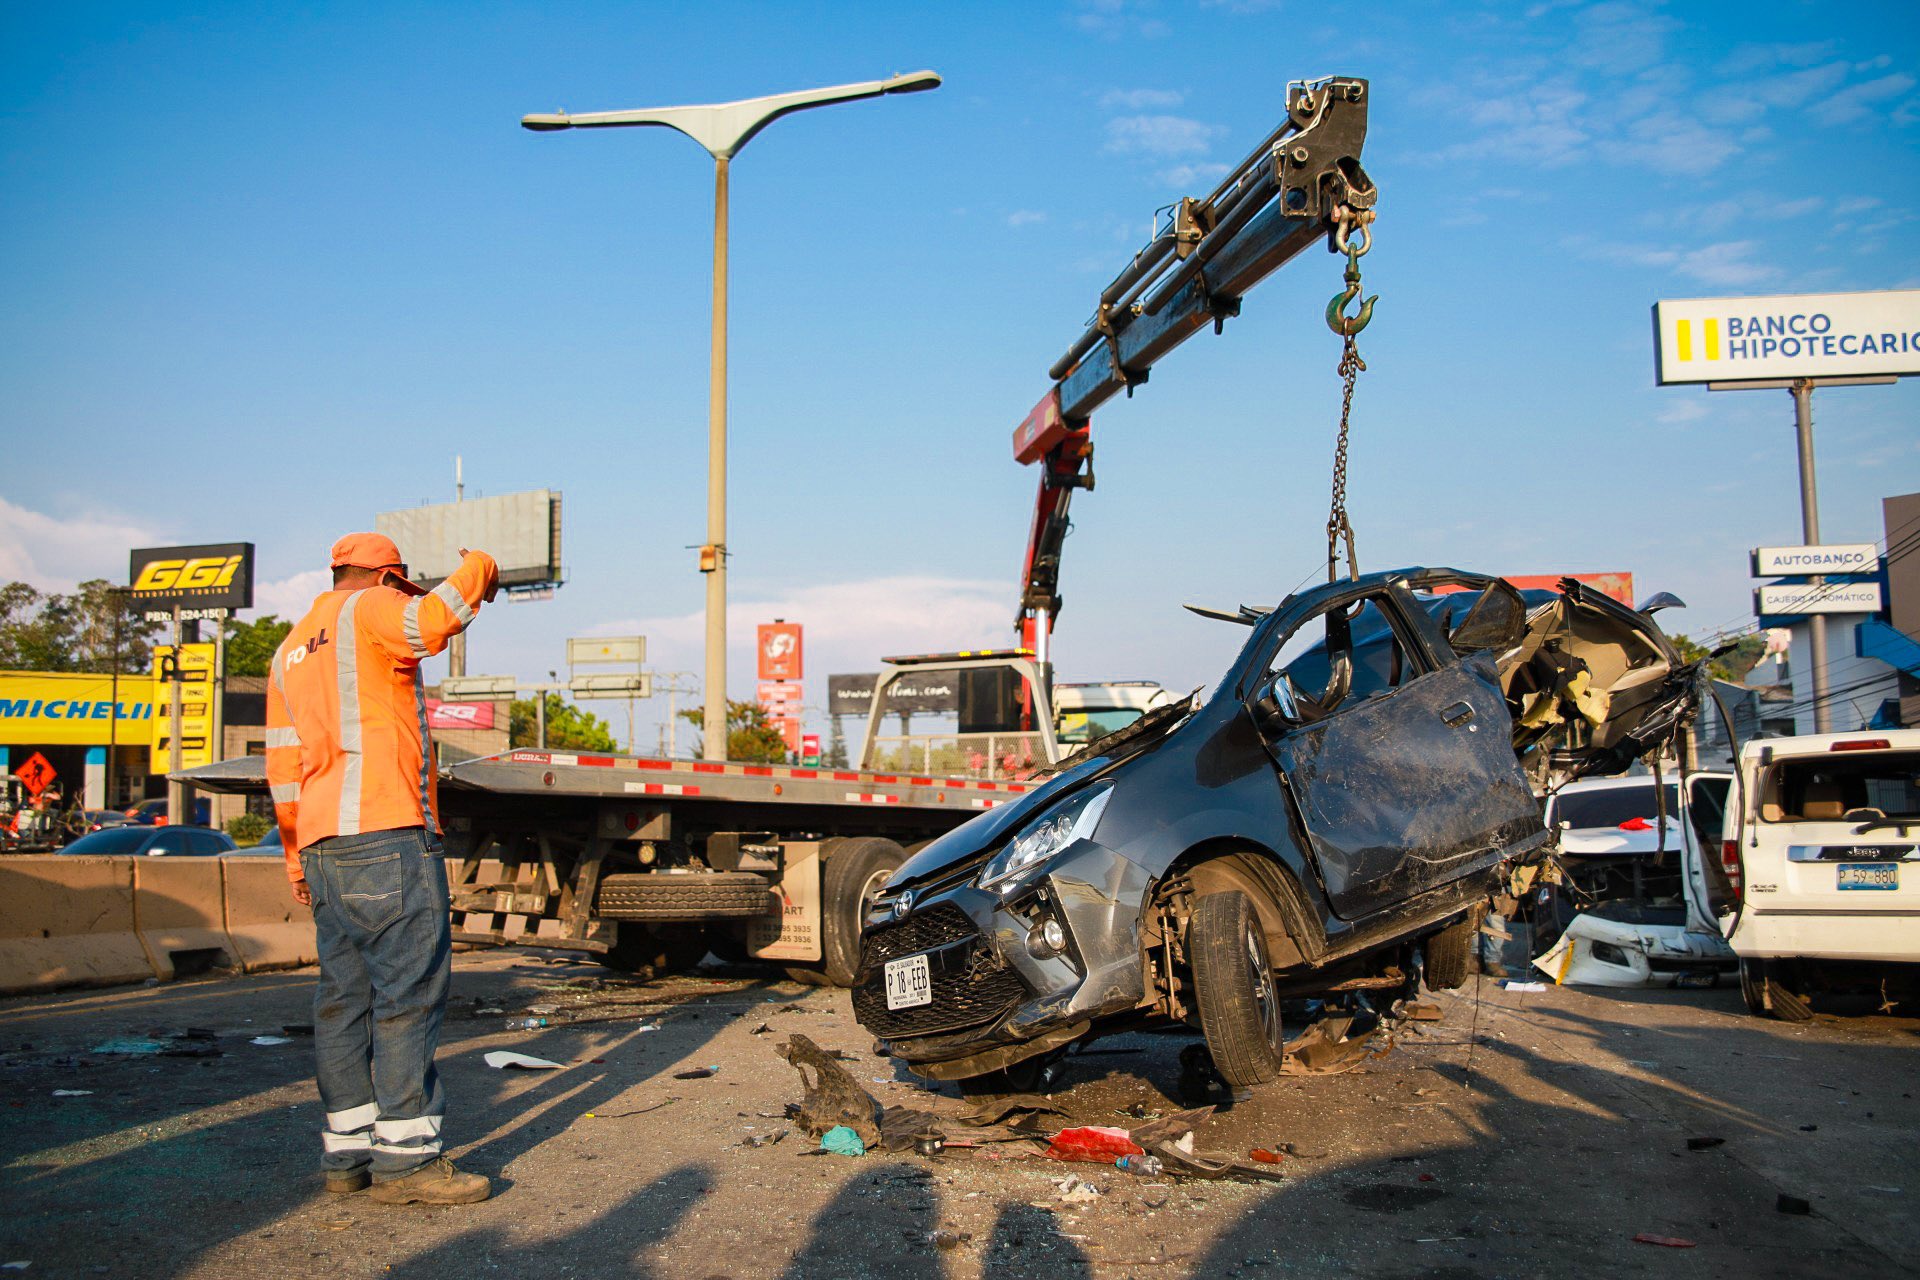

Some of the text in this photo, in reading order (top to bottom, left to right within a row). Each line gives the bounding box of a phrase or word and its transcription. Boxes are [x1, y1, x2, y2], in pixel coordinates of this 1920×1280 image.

[1727, 313, 1831, 338] BANCO
[1773, 553, 1864, 566] AUTOBANCO
[1767, 591, 1875, 604] CAJERO AUTOMÁTICO
[145, 611, 172, 622] PBX:
[1847, 846, 1881, 858] Jeep
[1839, 869, 1846, 884] P
[793, 925, 811, 933] 3935
[793, 936, 812, 944] 3936
[888, 966, 928, 996] P 18 EEB
